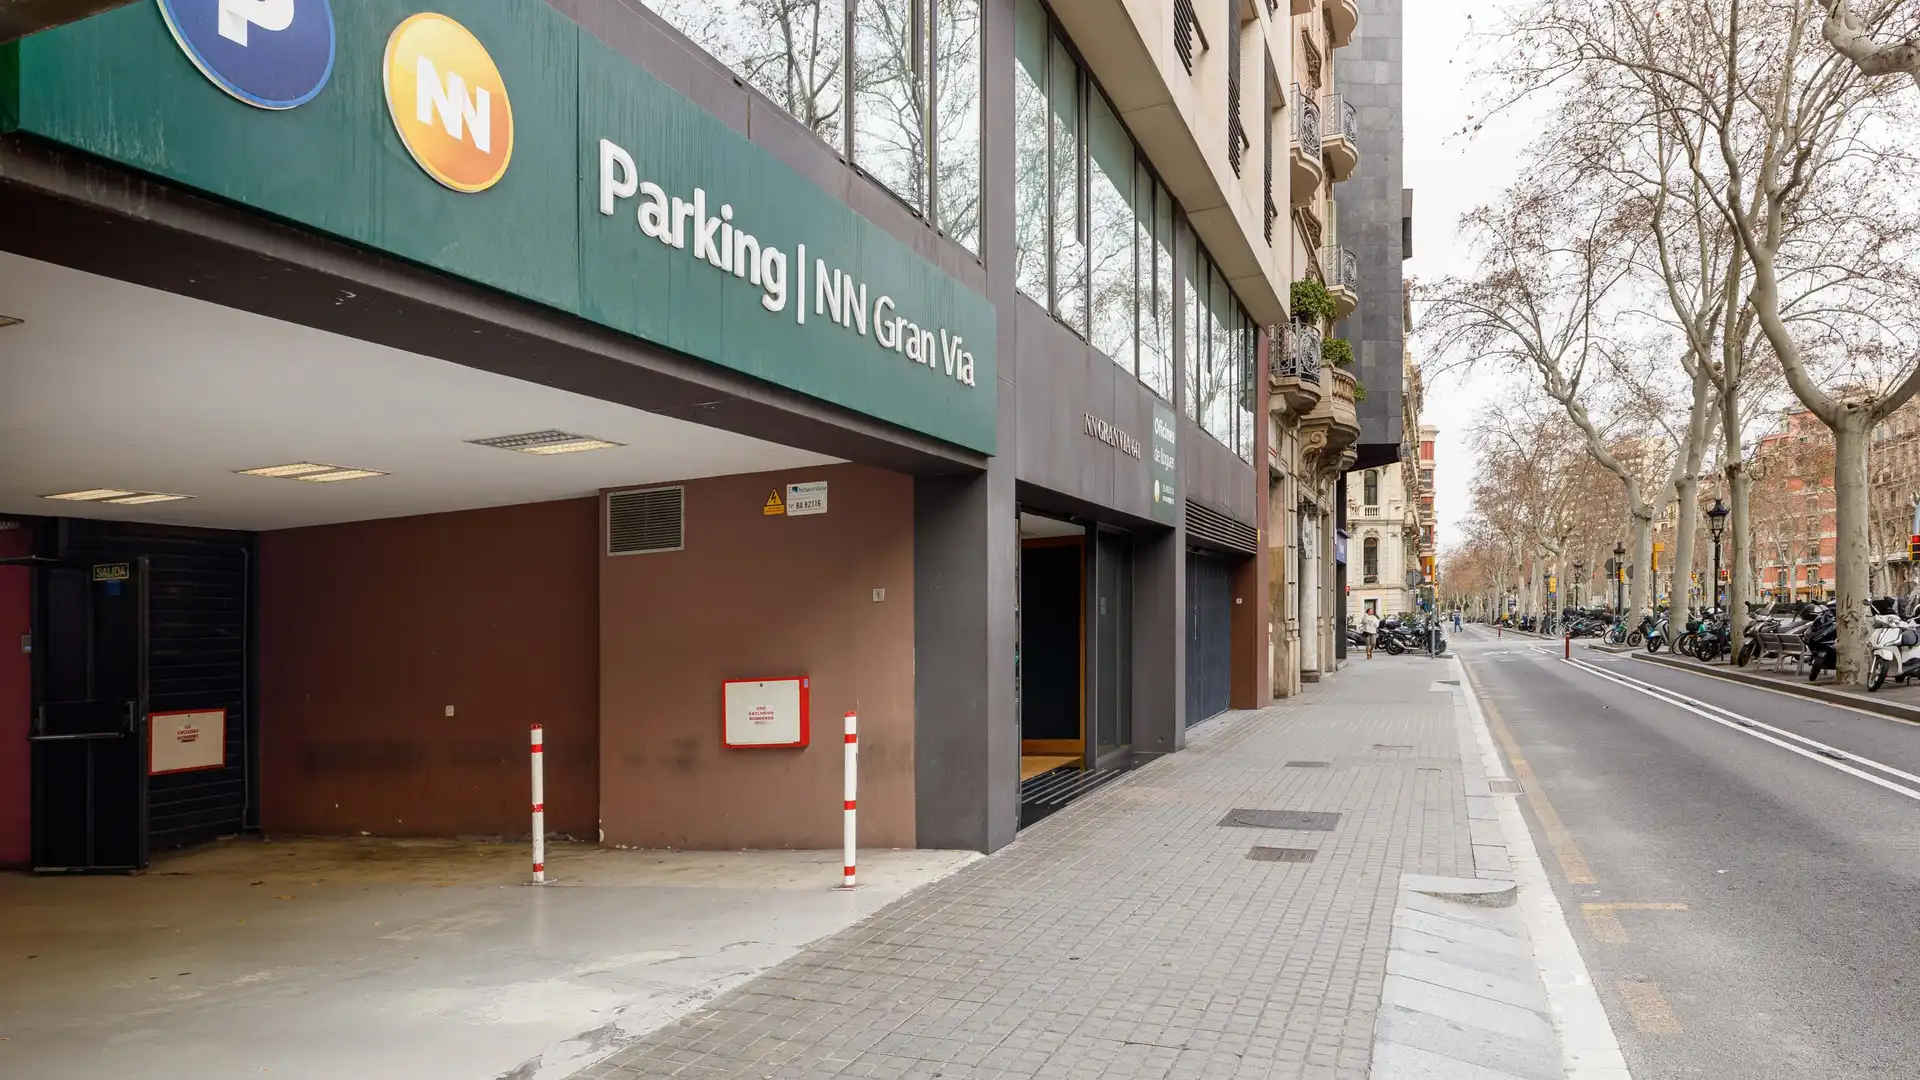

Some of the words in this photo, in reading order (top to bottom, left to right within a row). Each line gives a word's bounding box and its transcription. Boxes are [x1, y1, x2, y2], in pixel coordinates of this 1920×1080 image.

[417, 53, 491, 155] NN
[599, 138, 787, 312] Parking
[815, 258, 867, 336] NN
[873, 295, 936, 368] Gran
[940, 328, 975, 387] Via
[1097, 419, 1119, 448] GRAN
[1119, 430, 1131, 455] VIA
[96, 565, 126, 578] SALIDA
